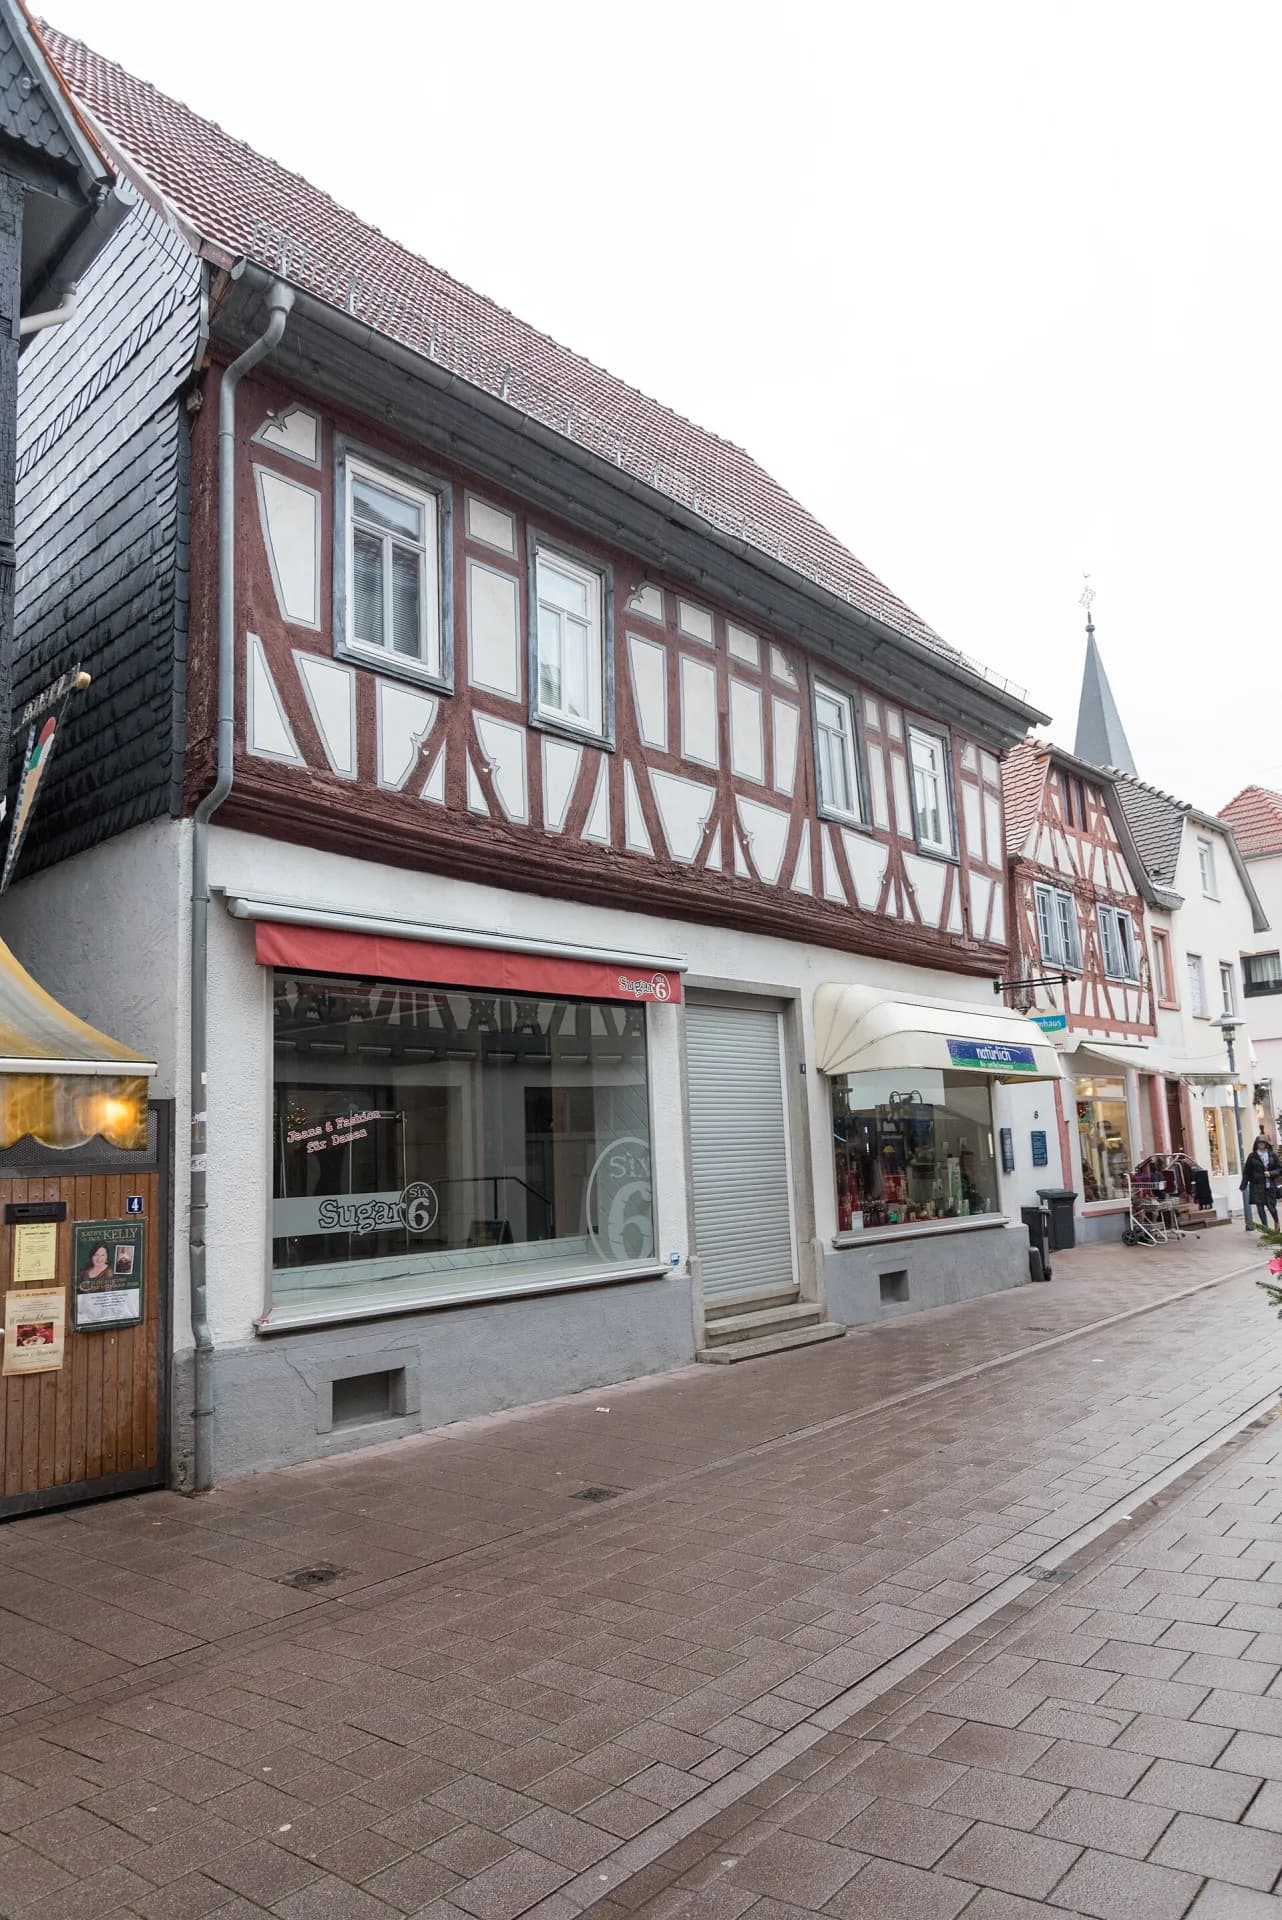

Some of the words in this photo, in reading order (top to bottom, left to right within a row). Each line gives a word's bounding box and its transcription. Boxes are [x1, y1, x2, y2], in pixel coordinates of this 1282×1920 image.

[618, 975, 655, 998] Sugar
[655, 982, 667, 999] 6
[976, 1046, 1011, 1061] natürlich
[287, 1126, 322, 1143] Jeans
[131, 1197, 140, 1212] 4
[319, 1199, 406, 1235] Sugar
[408, 1197, 430, 1229] 6
[103, 1228, 138, 1240] KELLY
